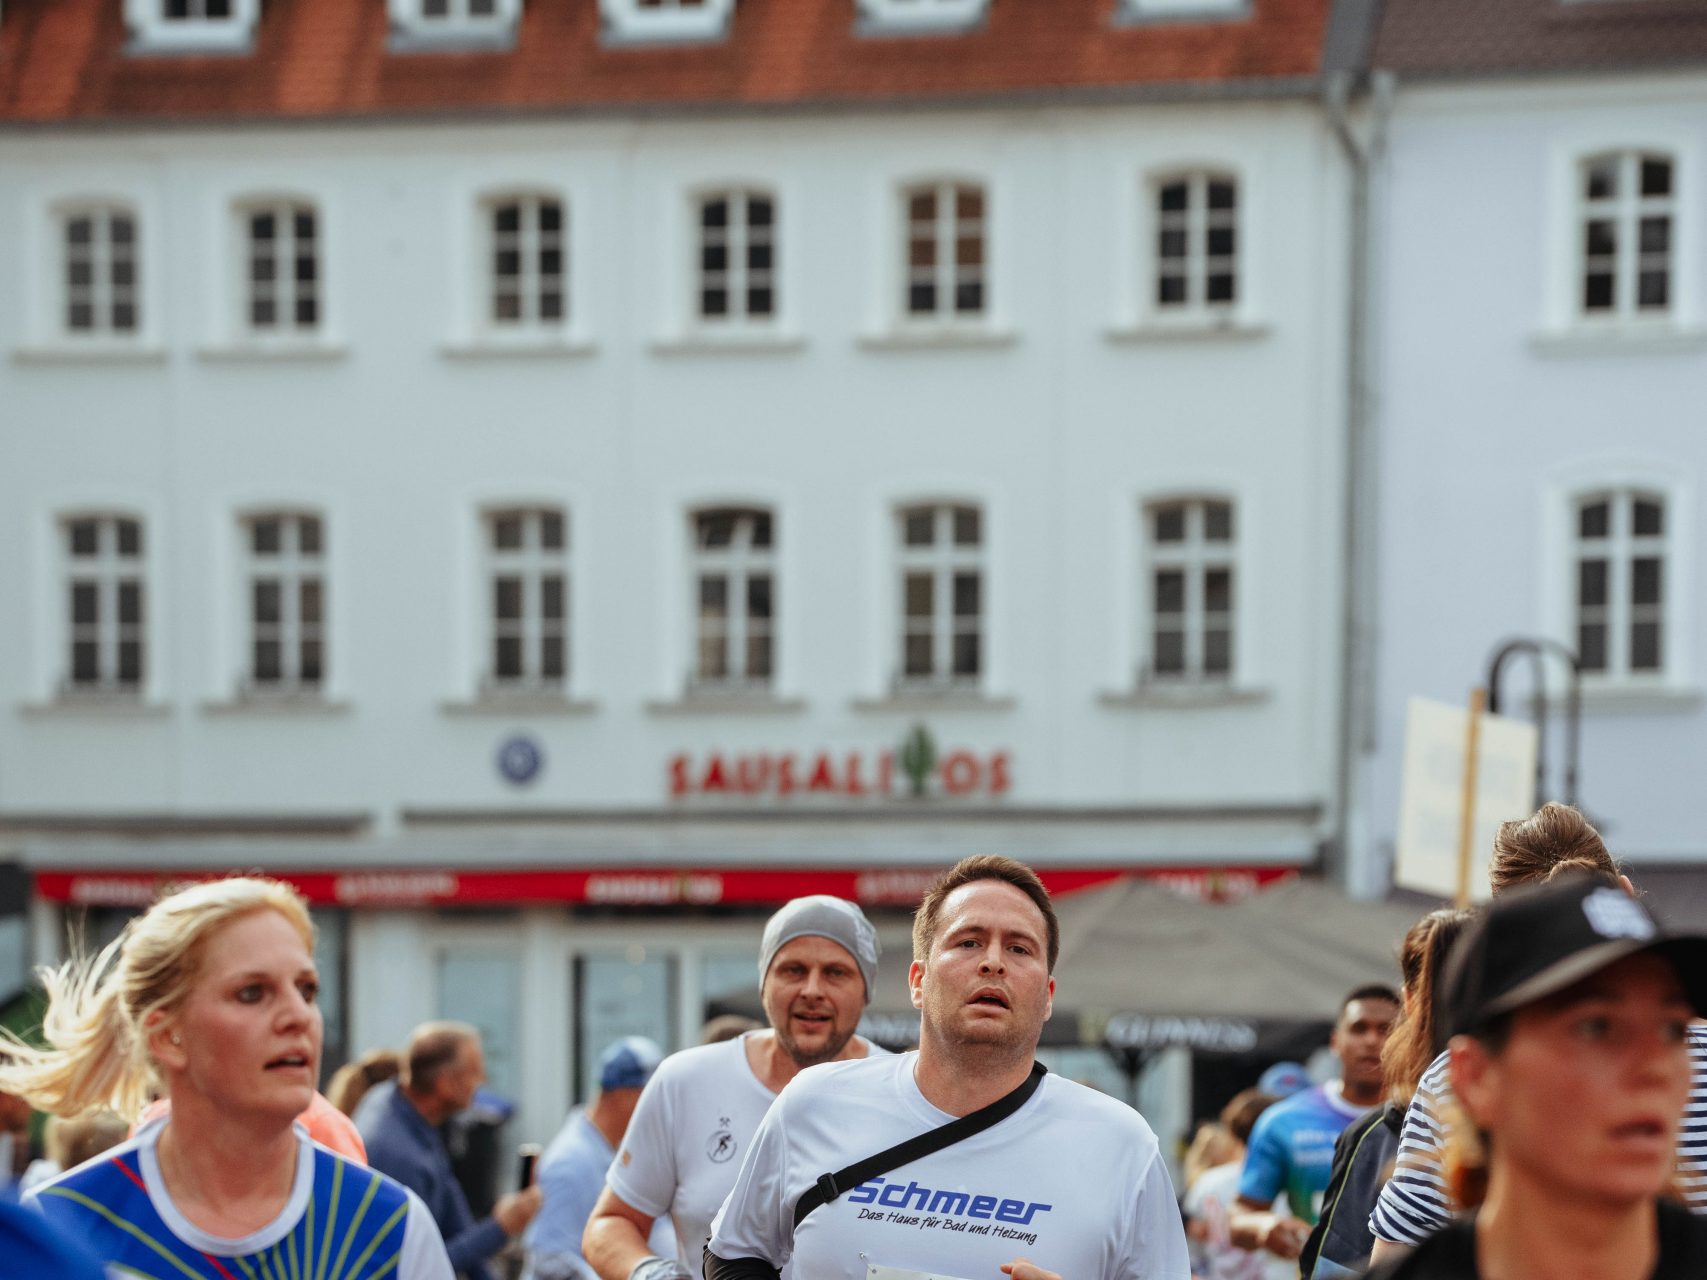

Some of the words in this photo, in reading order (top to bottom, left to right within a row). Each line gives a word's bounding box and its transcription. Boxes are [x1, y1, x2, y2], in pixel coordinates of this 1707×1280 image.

[668, 748, 1013, 796] SAUSALIOS
[847, 1177, 1053, 1226] Schmeer
[857, 1208, 885, 1220] Das
[887, 1212, 920, 1226] Haus
[920, 1217, 941, 1230] für
[943, 1219, 966, 1233] Bad
[968, 1225, 993, 1236] und
[992, 1227, 1038, 1246] Heizung
